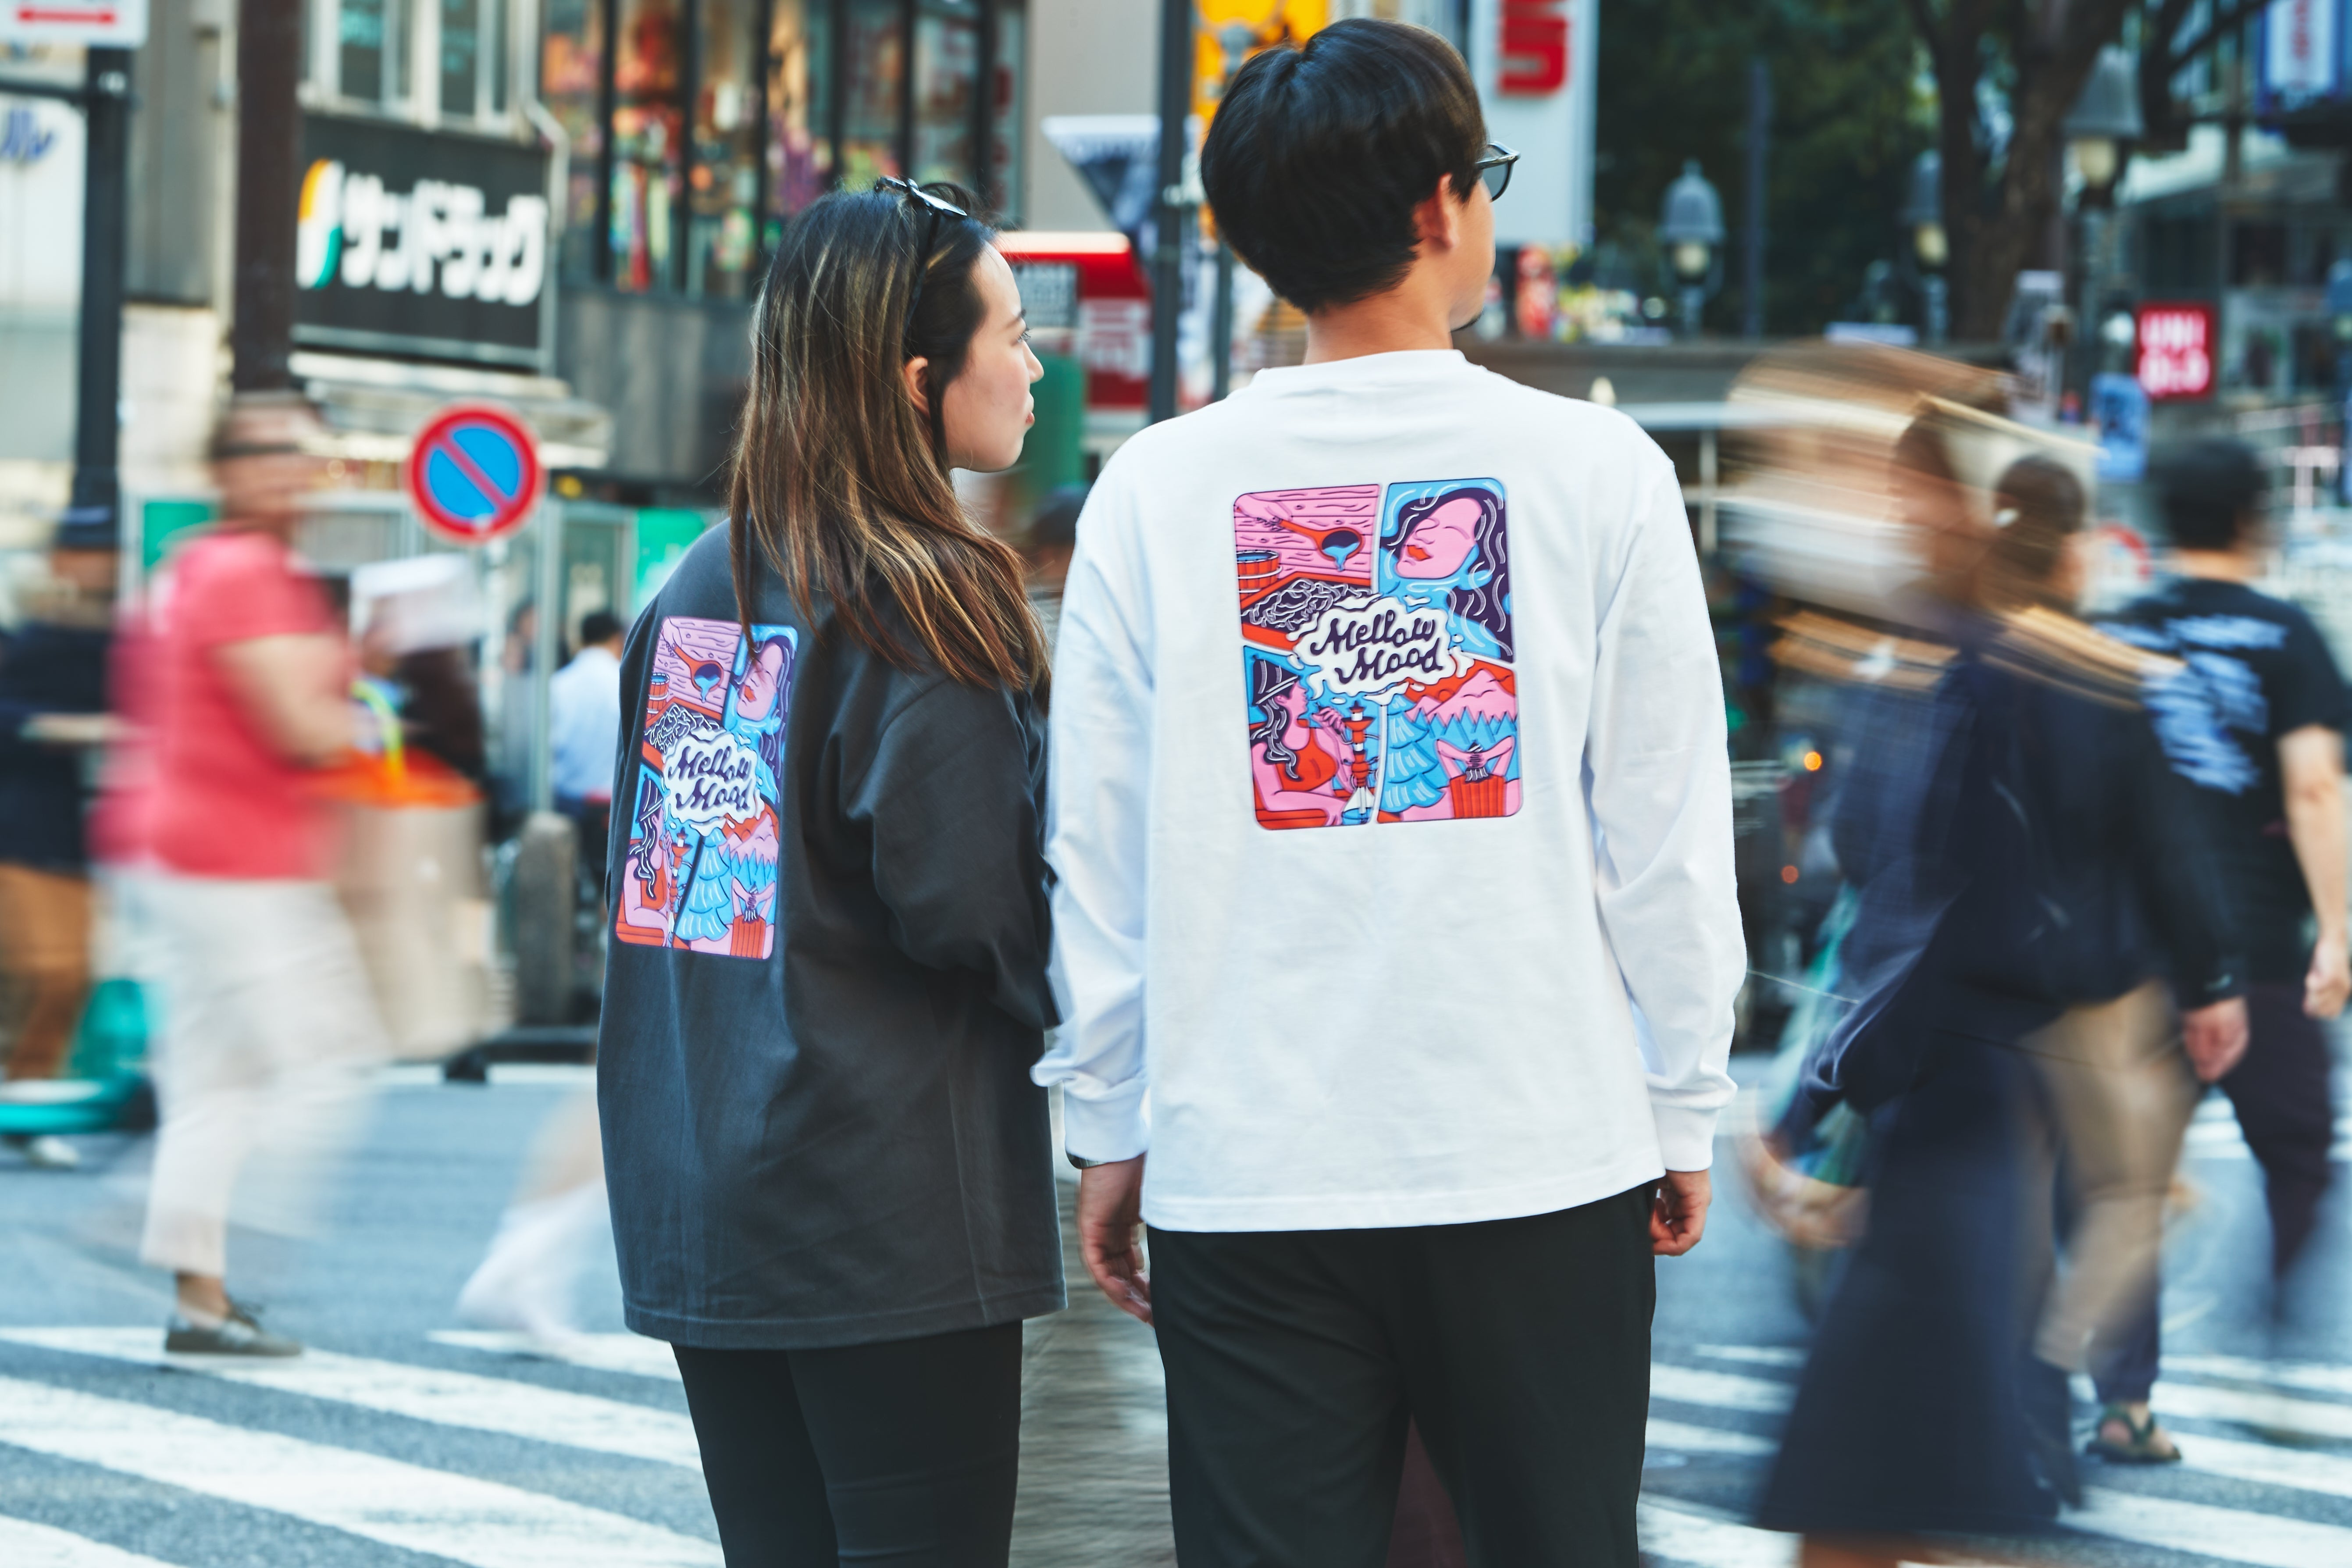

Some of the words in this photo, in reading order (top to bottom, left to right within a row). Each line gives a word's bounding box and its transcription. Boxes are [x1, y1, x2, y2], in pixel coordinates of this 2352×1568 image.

[1309, 609, 1436, 656] Mellow
[1334, 637, 1443, 684] Mood
[668, 745, 752, 784] Mellow
[675, 777, 752, 813] Mood
